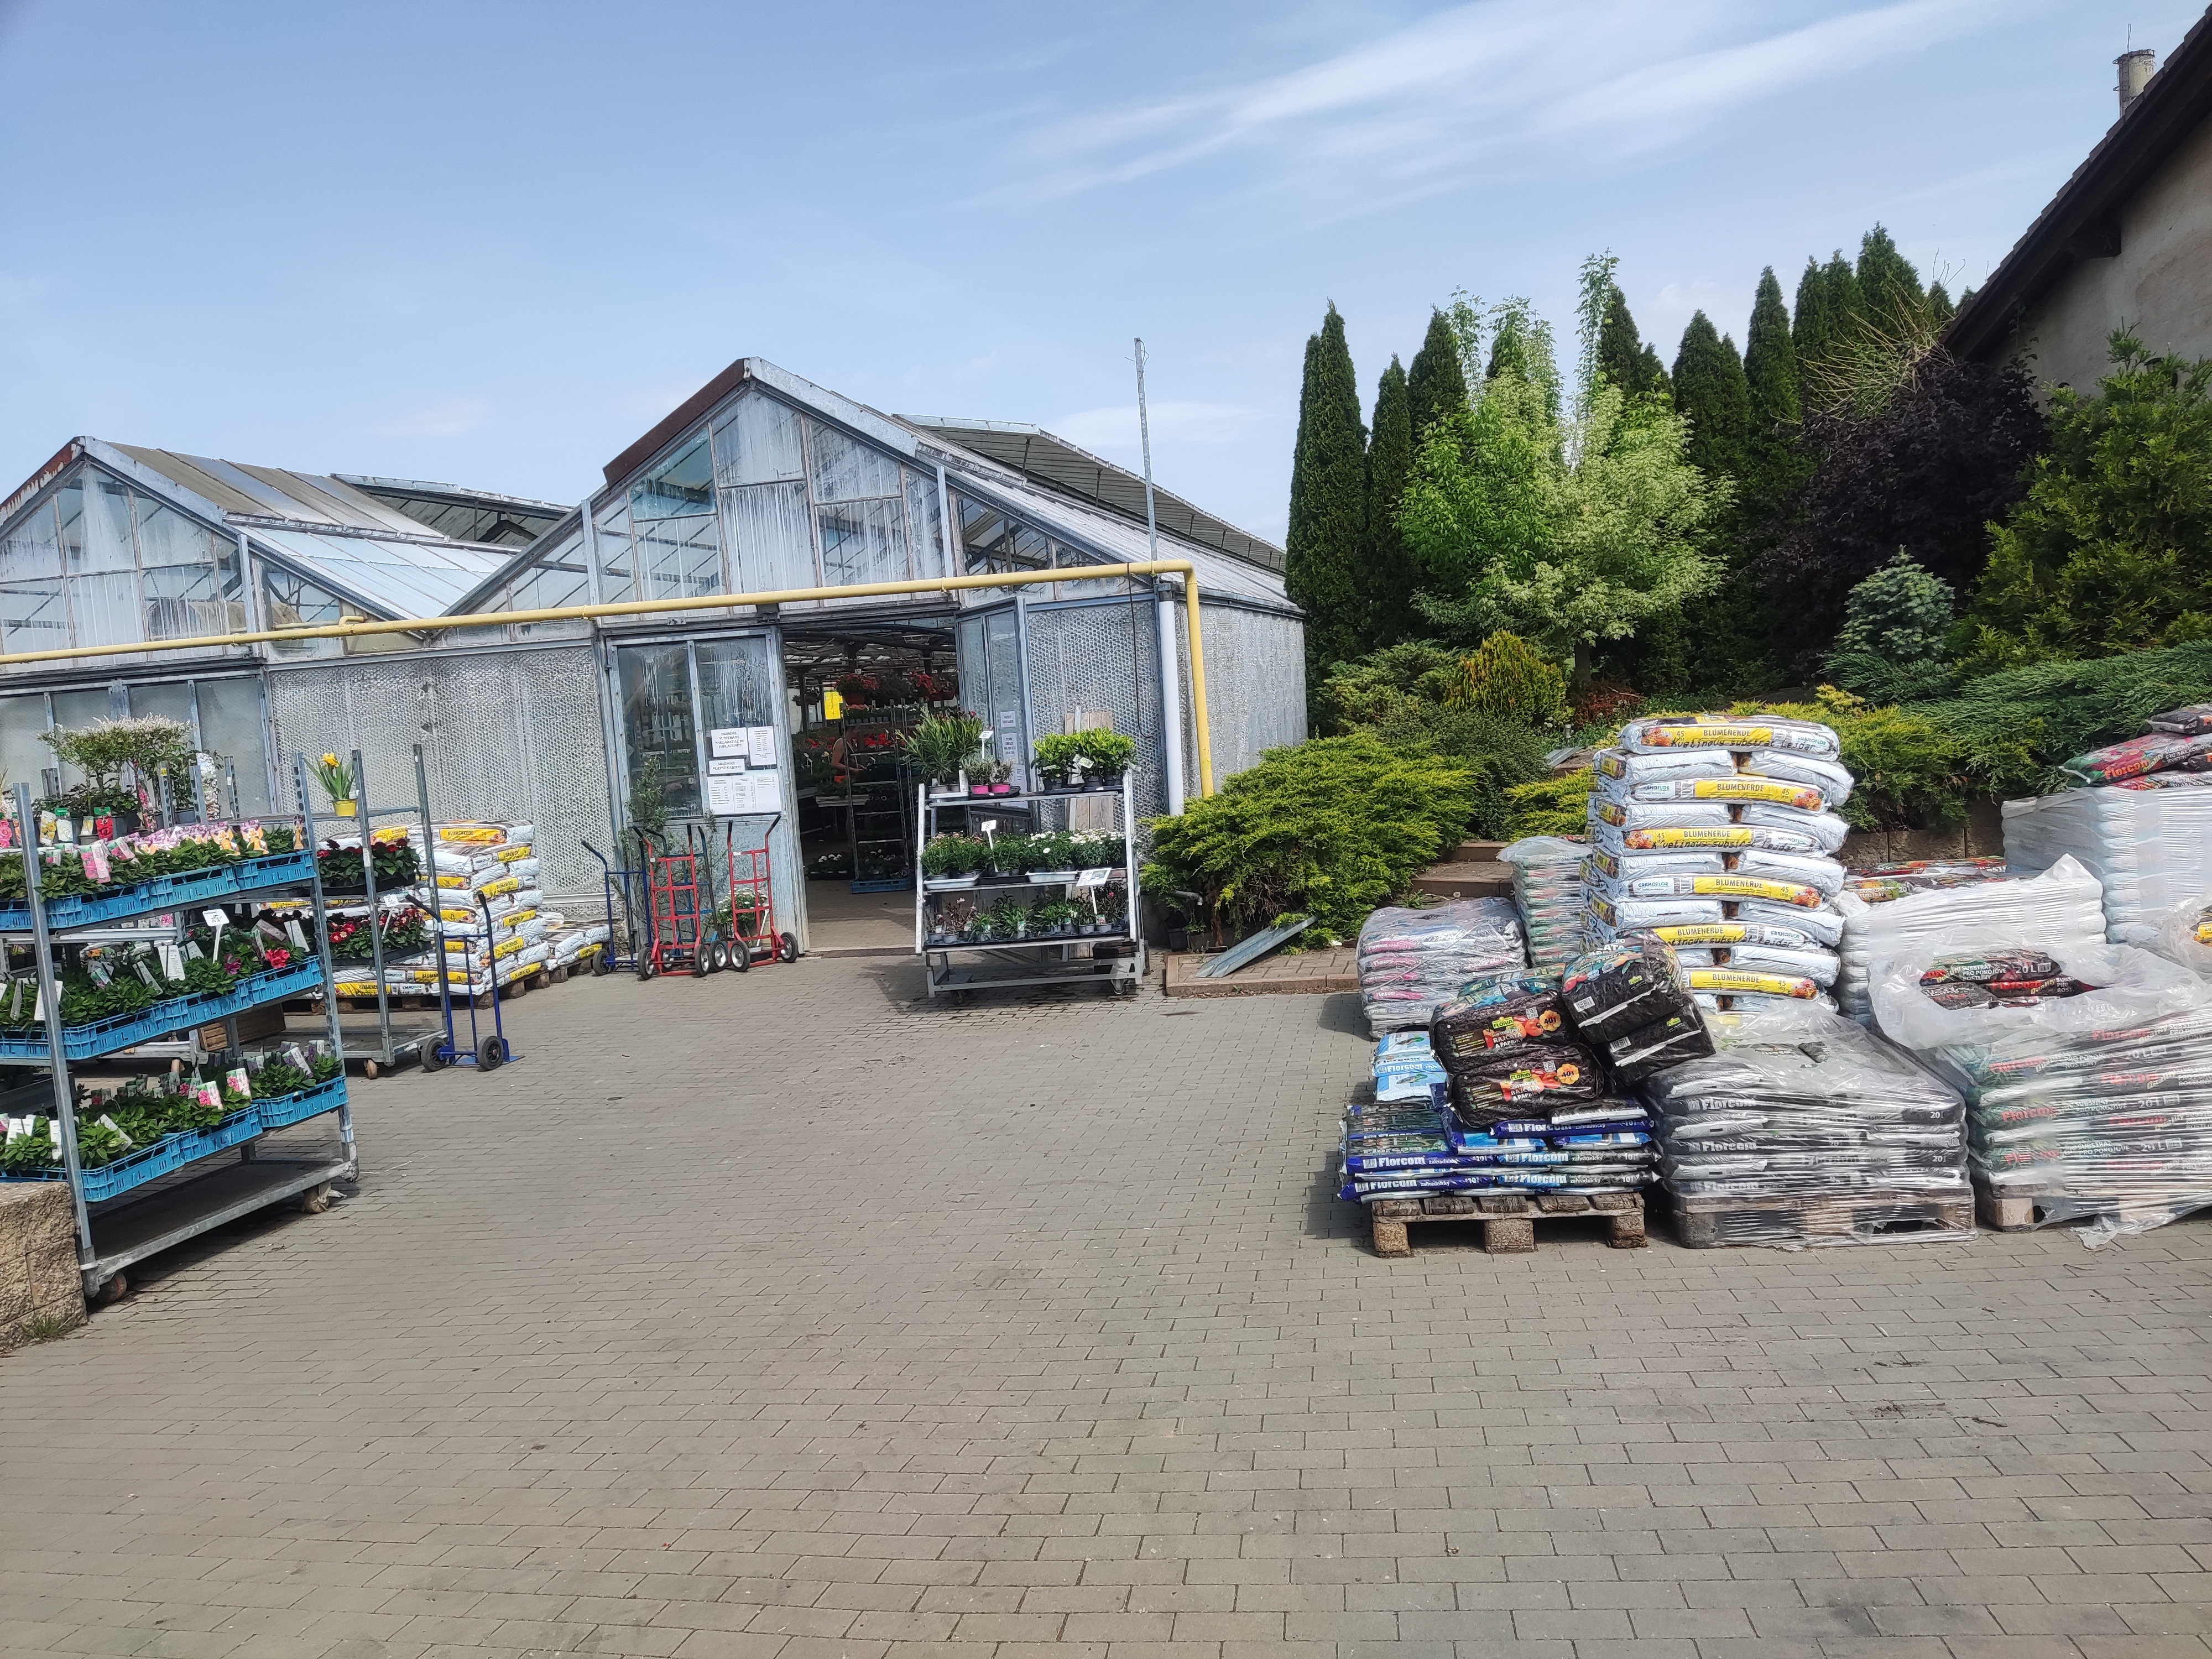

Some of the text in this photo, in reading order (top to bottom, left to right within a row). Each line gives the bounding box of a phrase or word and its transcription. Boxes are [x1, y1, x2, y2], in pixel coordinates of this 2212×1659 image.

[1703, 729, 1751, 737] BLUMENERDE
[1717, 783, 1765, 792] BLUMENERDE
[1715, 878, 1764, 889] BLUMENERDE
[1677, 927, 1724, 936] BLUMENERDE
[1712, 973, 1760, 983] BLUMENERDE
[1493, 1019, 1514, 1028] FLORIA
[1387, 1064, 1423, 1072] Florcom
[1702, 1141, 1757, 1152] Florcom
[1379, 1156, 1426, 1167] Florcom
[1521, 1152, 1569, 1162] Florcom
[1519, 1173, 1567, 1184] Florcom
[1370, 1179, 1417, 1190] Florcom
